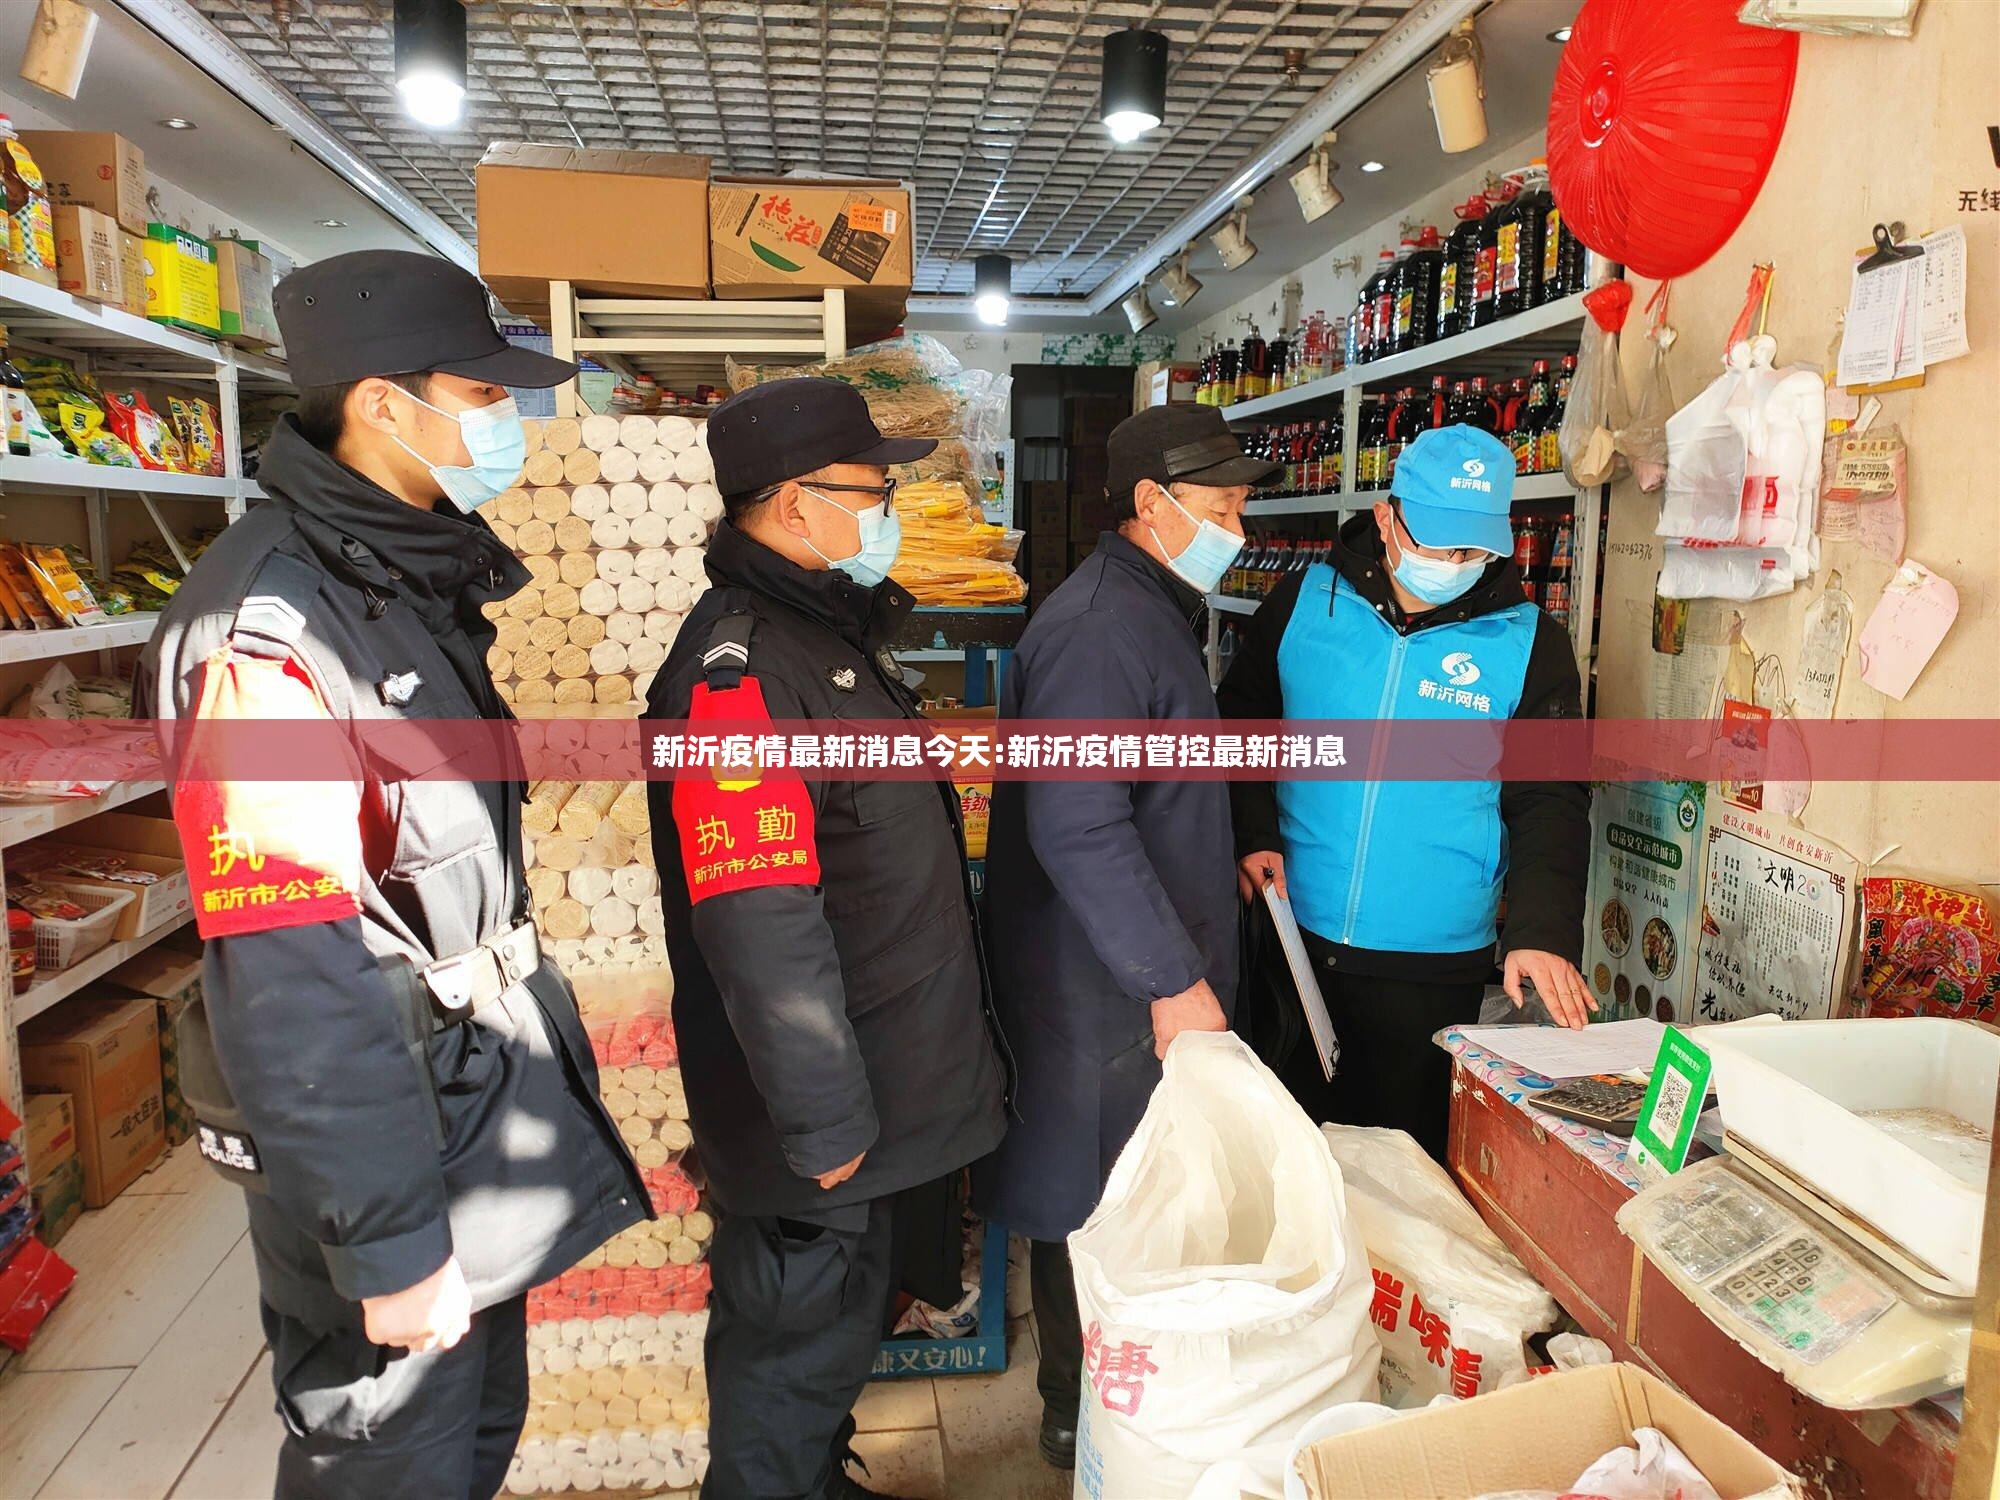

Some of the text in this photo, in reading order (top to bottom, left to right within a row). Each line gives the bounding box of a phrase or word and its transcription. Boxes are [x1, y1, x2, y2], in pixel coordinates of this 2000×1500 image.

[1450, 476, 1491, 493] 新沂网格
[1418, 679, 1491, 713] 新沂网格
[695, 804, 797, 857] 执勤
[1610, 827, 1678, 865] 食品安全示范城市
[1722, 812, 1772, 841] 建设文明城市
[1779, 833, 1834, 865] 共创食安新沂
[693, 850, 808, 884] 新沂市公安局
[202, 875, 350, 913] 新沂市公安
[110, 1095, 160, 1140] 一级大豆油
[200, 1142, 256, 1171] POLICE
